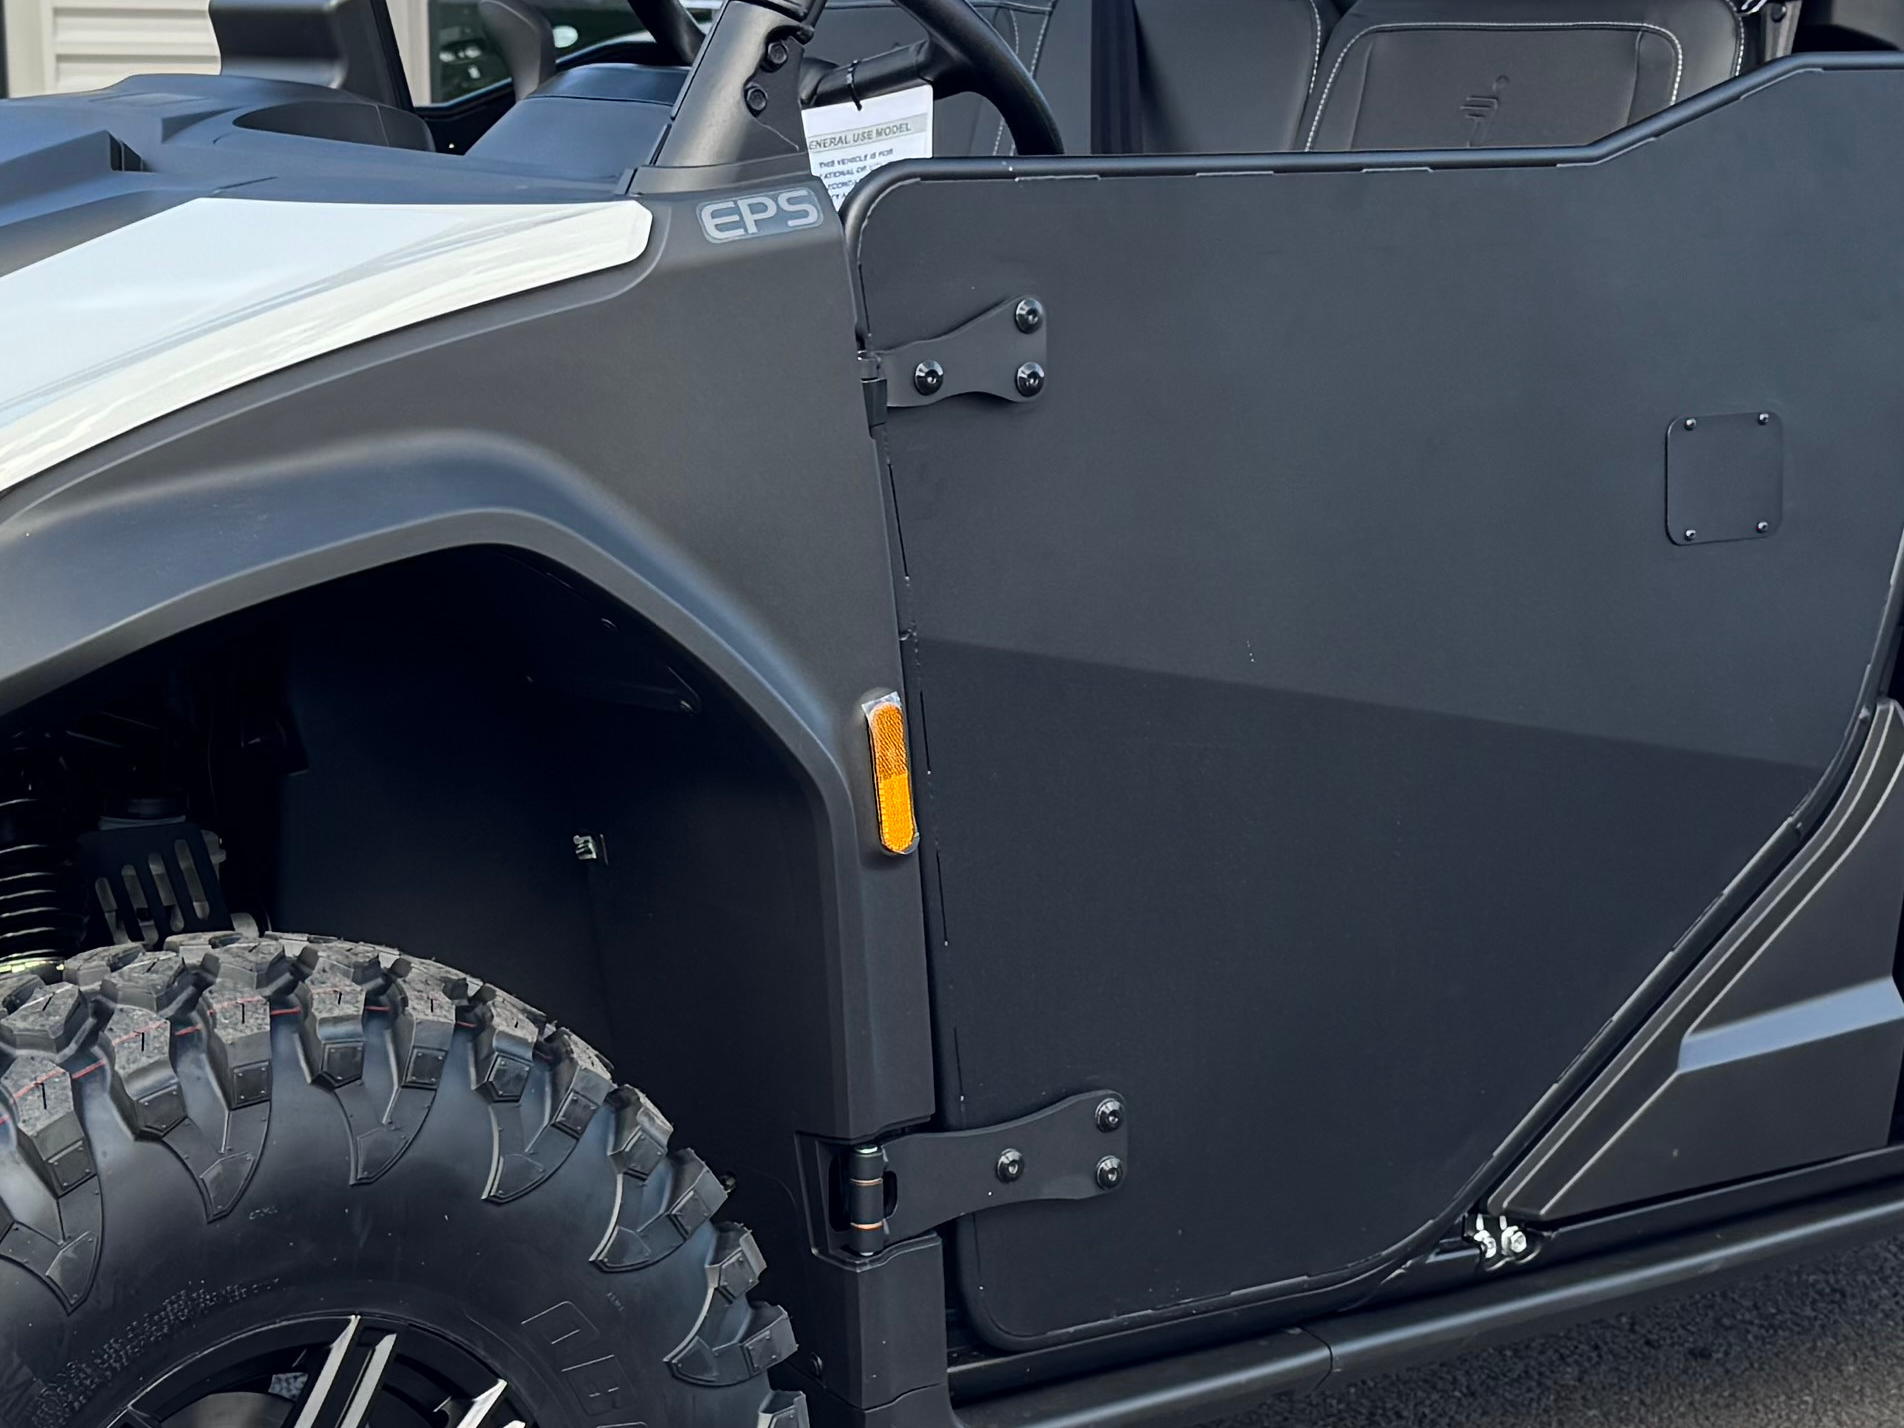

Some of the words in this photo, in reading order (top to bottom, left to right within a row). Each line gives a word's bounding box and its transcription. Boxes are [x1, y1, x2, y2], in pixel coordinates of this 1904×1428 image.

[852, 129, 874, 144] USE
[876, 122, 912, 140] MODEL
[820, 167, 854, 180] ATIONAL
[700, 189, 819, 240] EPS
